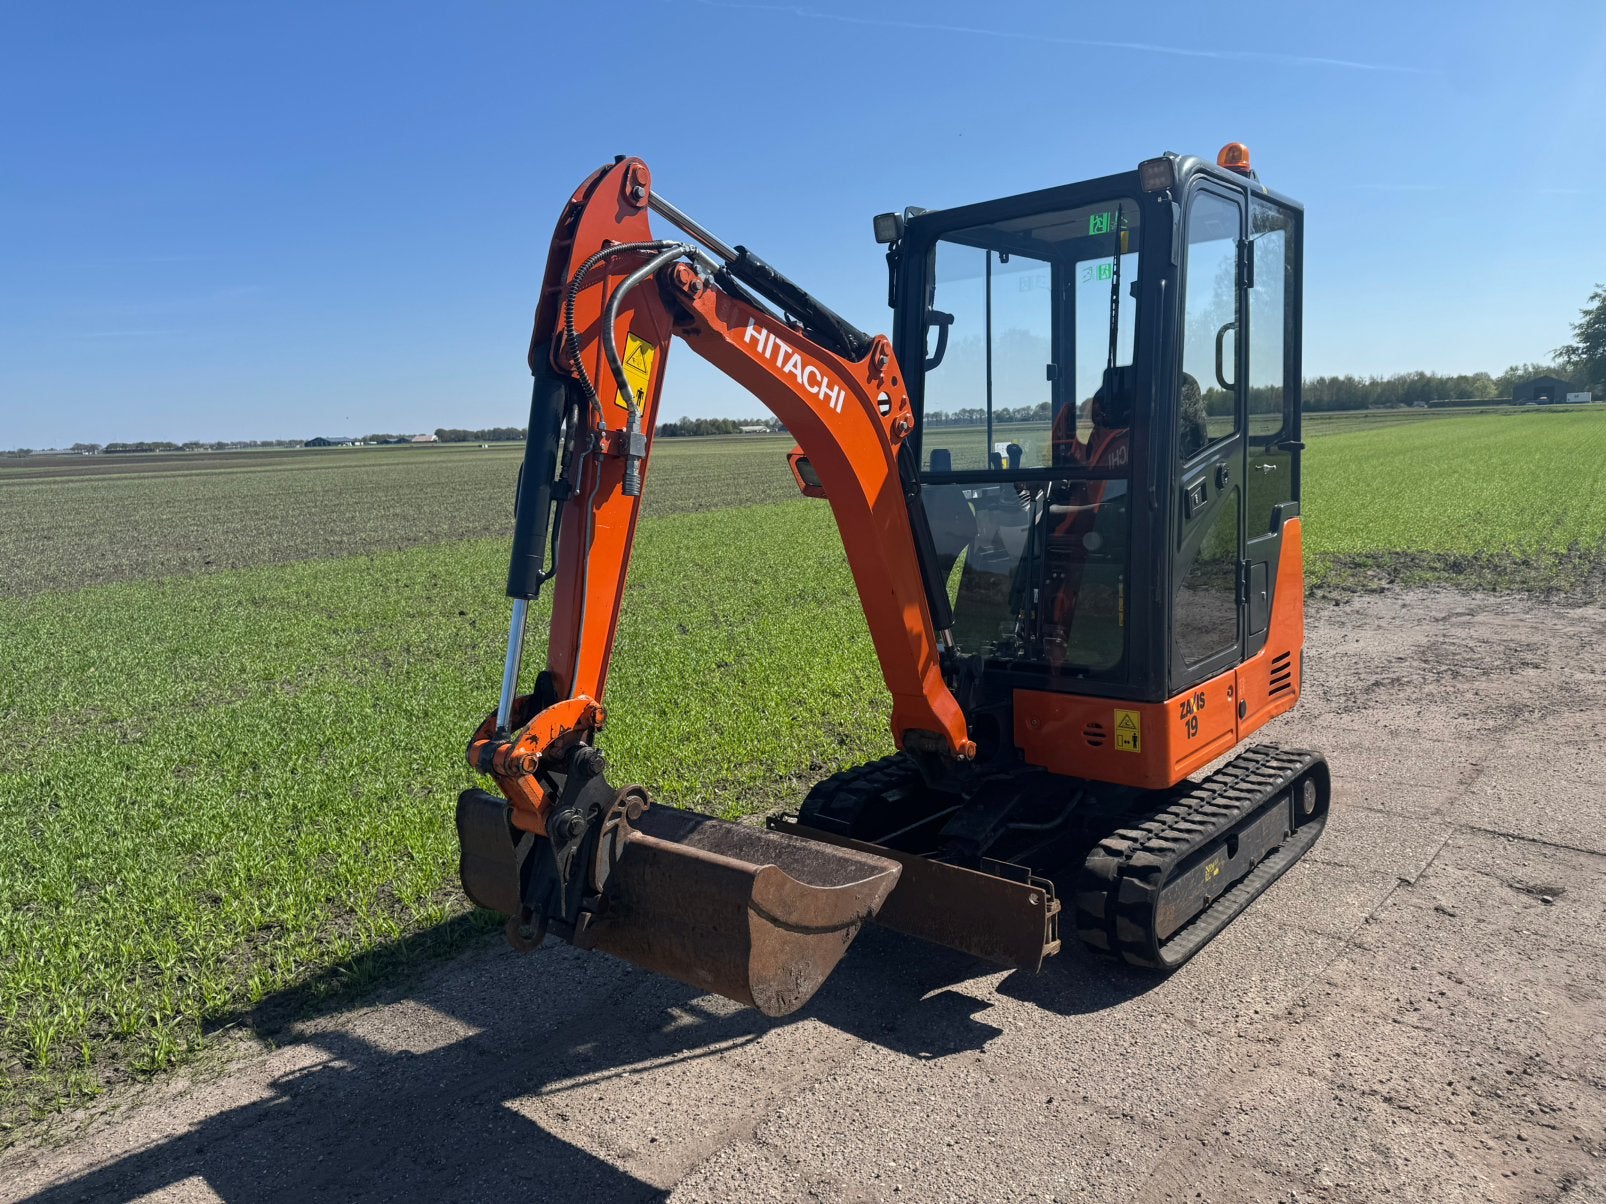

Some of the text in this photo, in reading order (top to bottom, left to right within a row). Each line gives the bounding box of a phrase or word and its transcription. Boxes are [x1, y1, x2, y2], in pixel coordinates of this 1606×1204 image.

[743, 317, 846, 414] HITACHI
[1180, 691, 1206, 721] ZAXIS
[1185, 715, 1199, 739] 19
